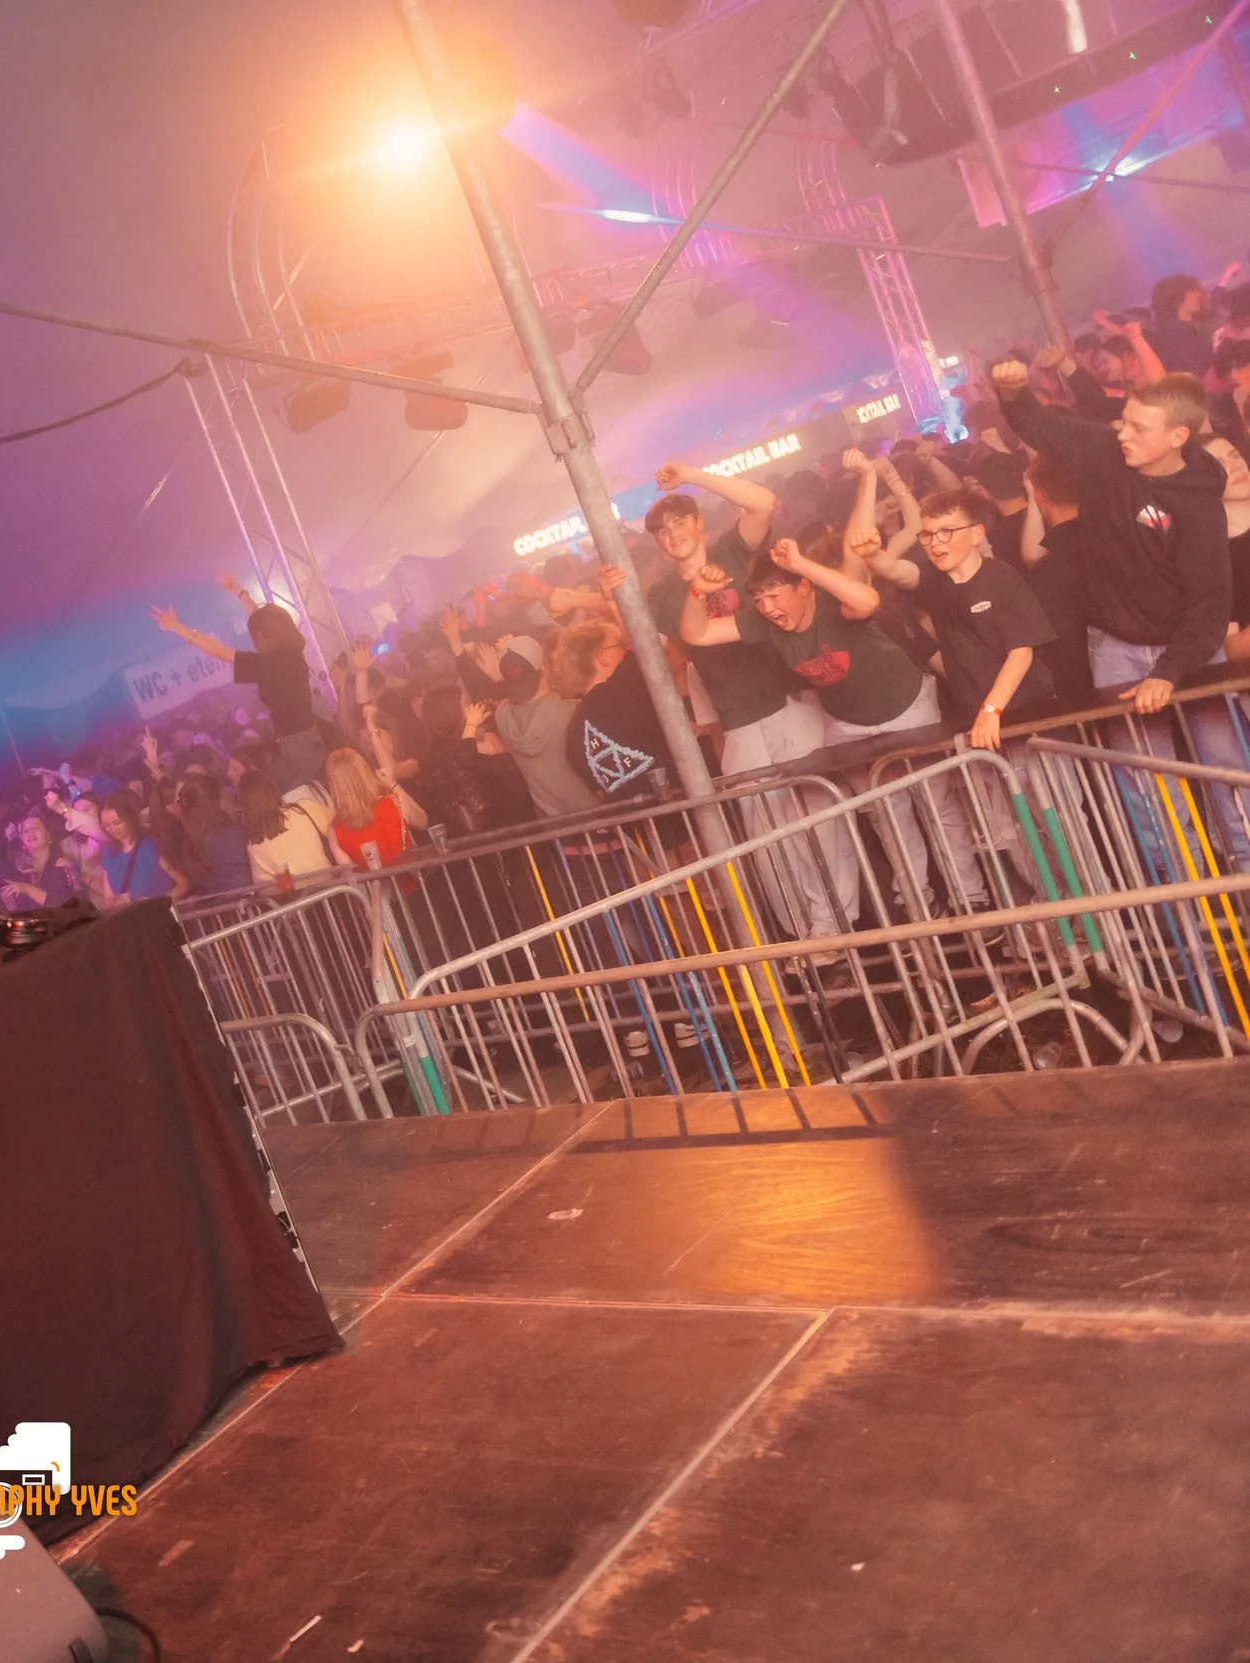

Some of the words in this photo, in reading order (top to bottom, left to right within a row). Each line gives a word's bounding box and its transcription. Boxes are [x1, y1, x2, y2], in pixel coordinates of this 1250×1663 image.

[767, 433, 802, 459] BAR
[132, 671, 168, 704] WC
[590, 738, 600, 750] H
[623, 757, 632, 768] F
